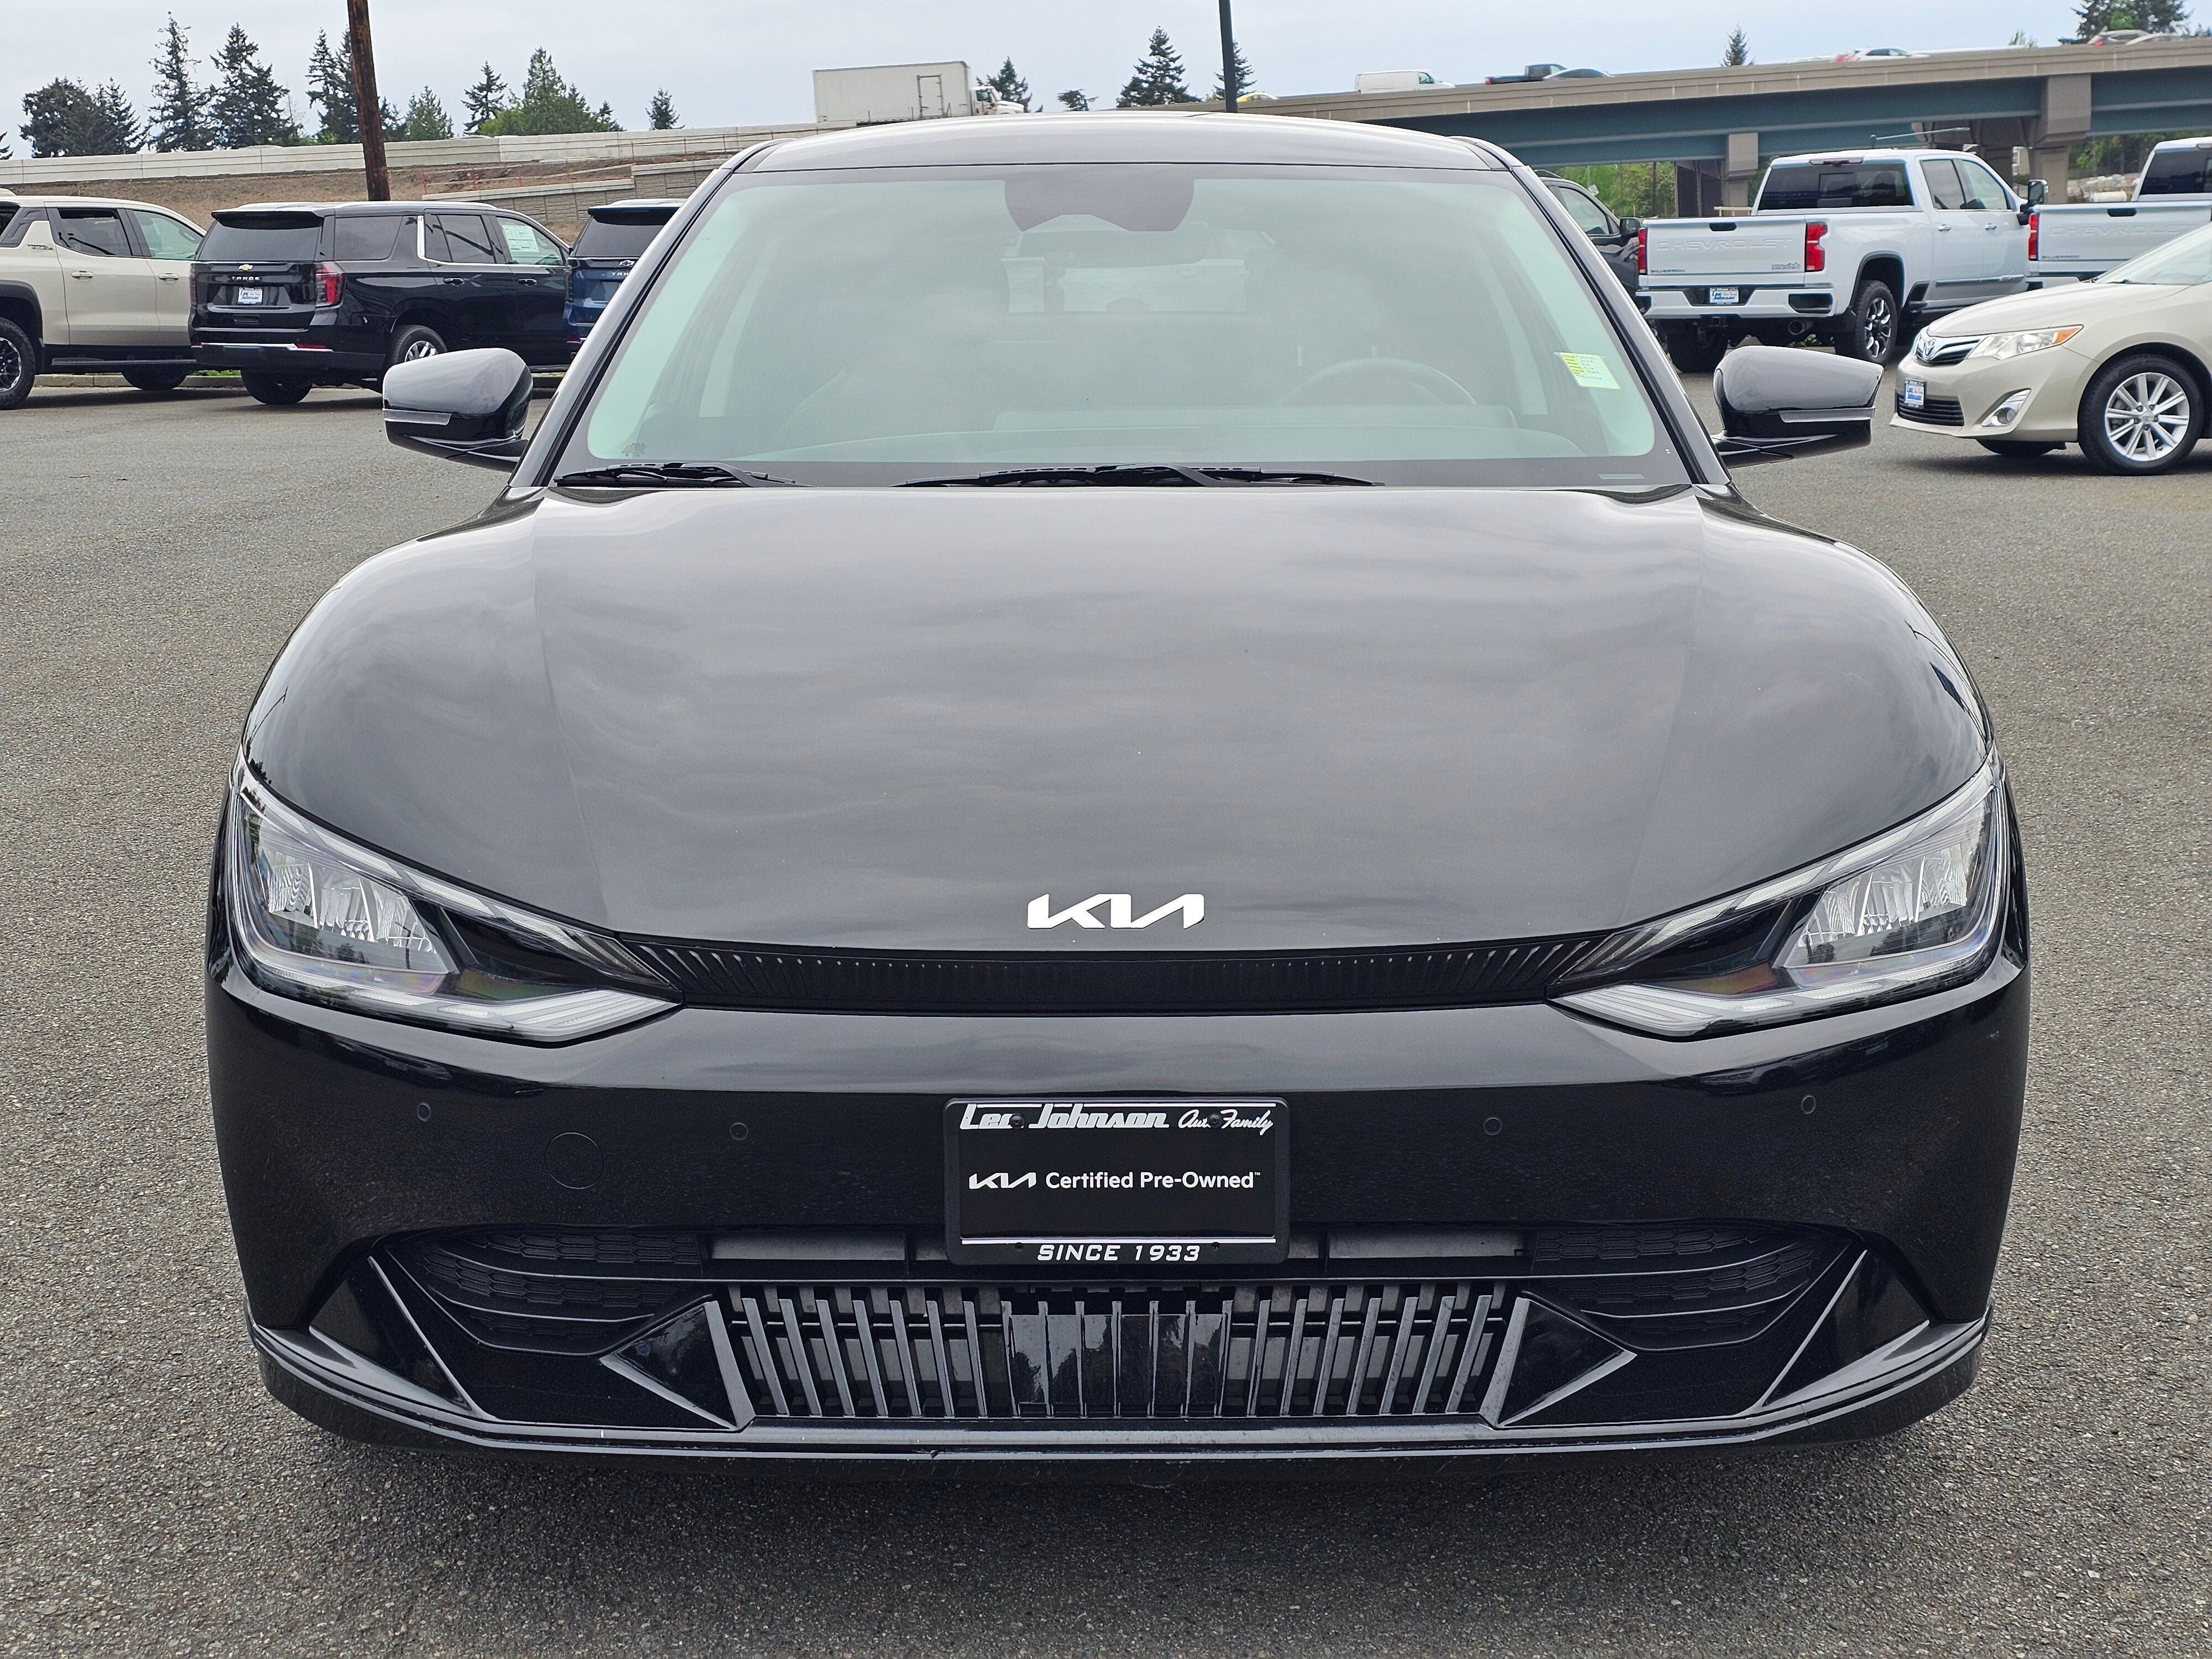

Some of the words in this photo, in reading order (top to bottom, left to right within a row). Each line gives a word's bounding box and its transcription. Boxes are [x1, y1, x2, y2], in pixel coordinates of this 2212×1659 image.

[1657, 238, 1793, 251] CHEVROLET
[1027, 893, 1205, 930] KIA
[1028, 1103, 1170, 1129] Johnson
[1178, 1109, 1212, 1129] Aut
[1220, 1109, 1274, 1136] Family
[969, 1172, 1037, 1190] KIA
[1046, 1171, 1133, 1189] Certified
[1037, 1244, 1121, 1261] SINCE
[1135, 1245, 1200, 1261] 1933
